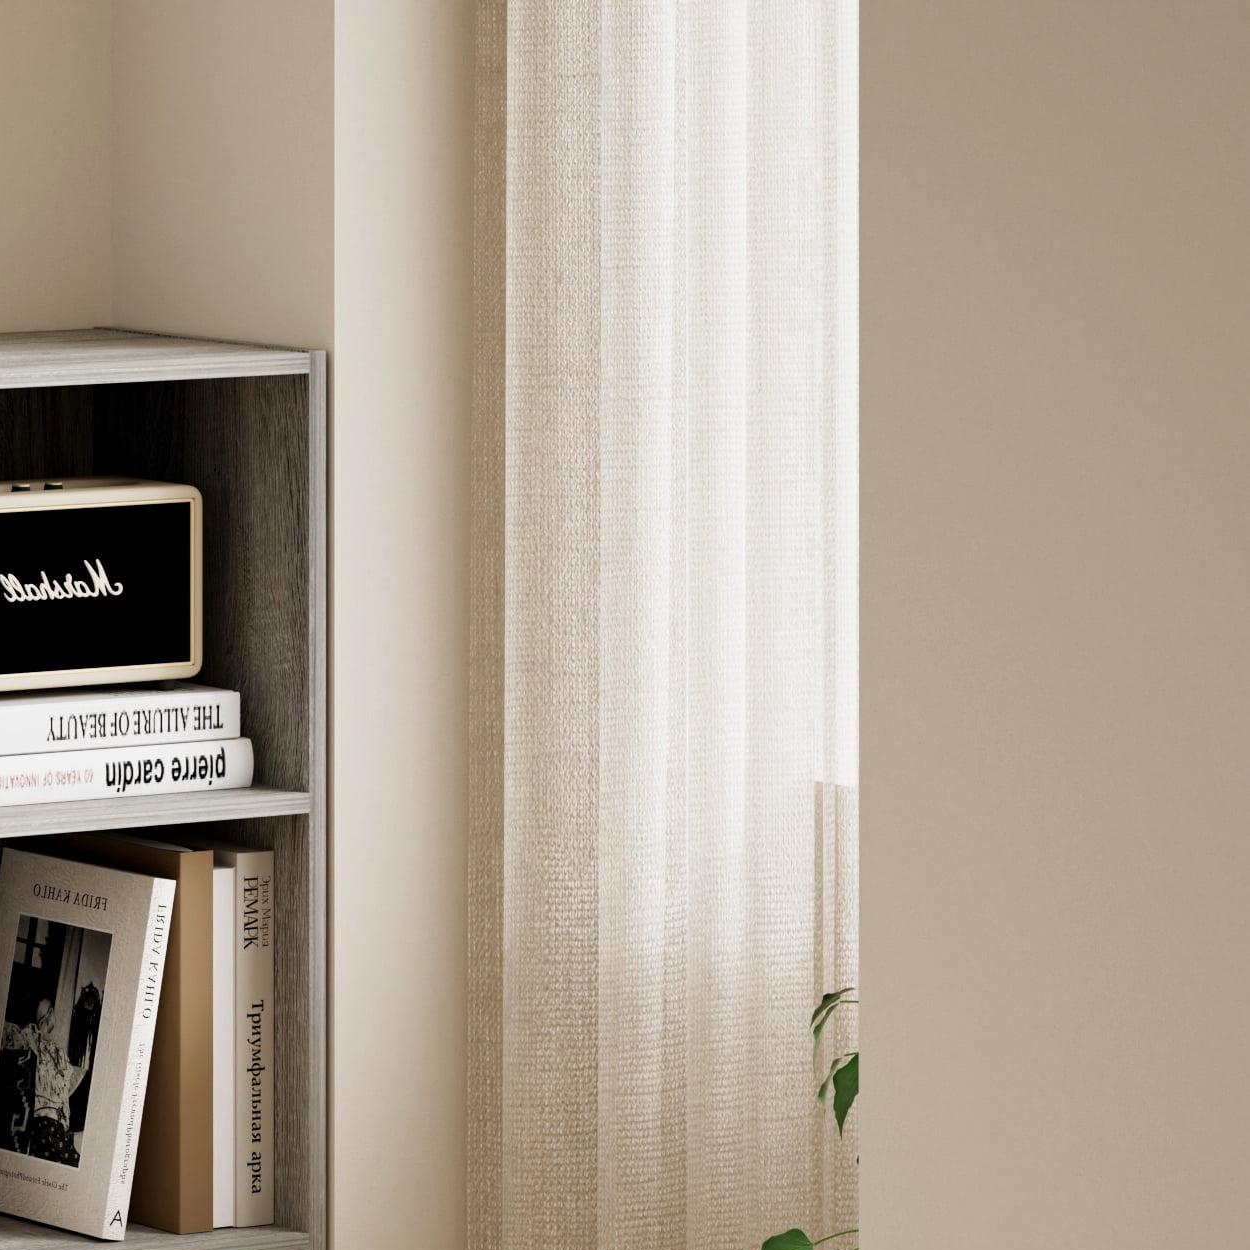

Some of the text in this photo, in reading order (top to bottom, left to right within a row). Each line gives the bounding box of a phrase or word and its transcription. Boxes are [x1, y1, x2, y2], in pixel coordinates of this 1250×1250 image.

[47, 704, 224, 741] THE ALLURE OF BEAUTY
[43, 772, 53, 786] OF
[56, 770, 82, 786] YEARS
[105, 747, 226, 792] pierre cardin
[244, 877, 259, 950] РЕМАРК
[247, 1000, 266, 1194] Триумфальная арка
[109, 1209, 123, 1227] A
